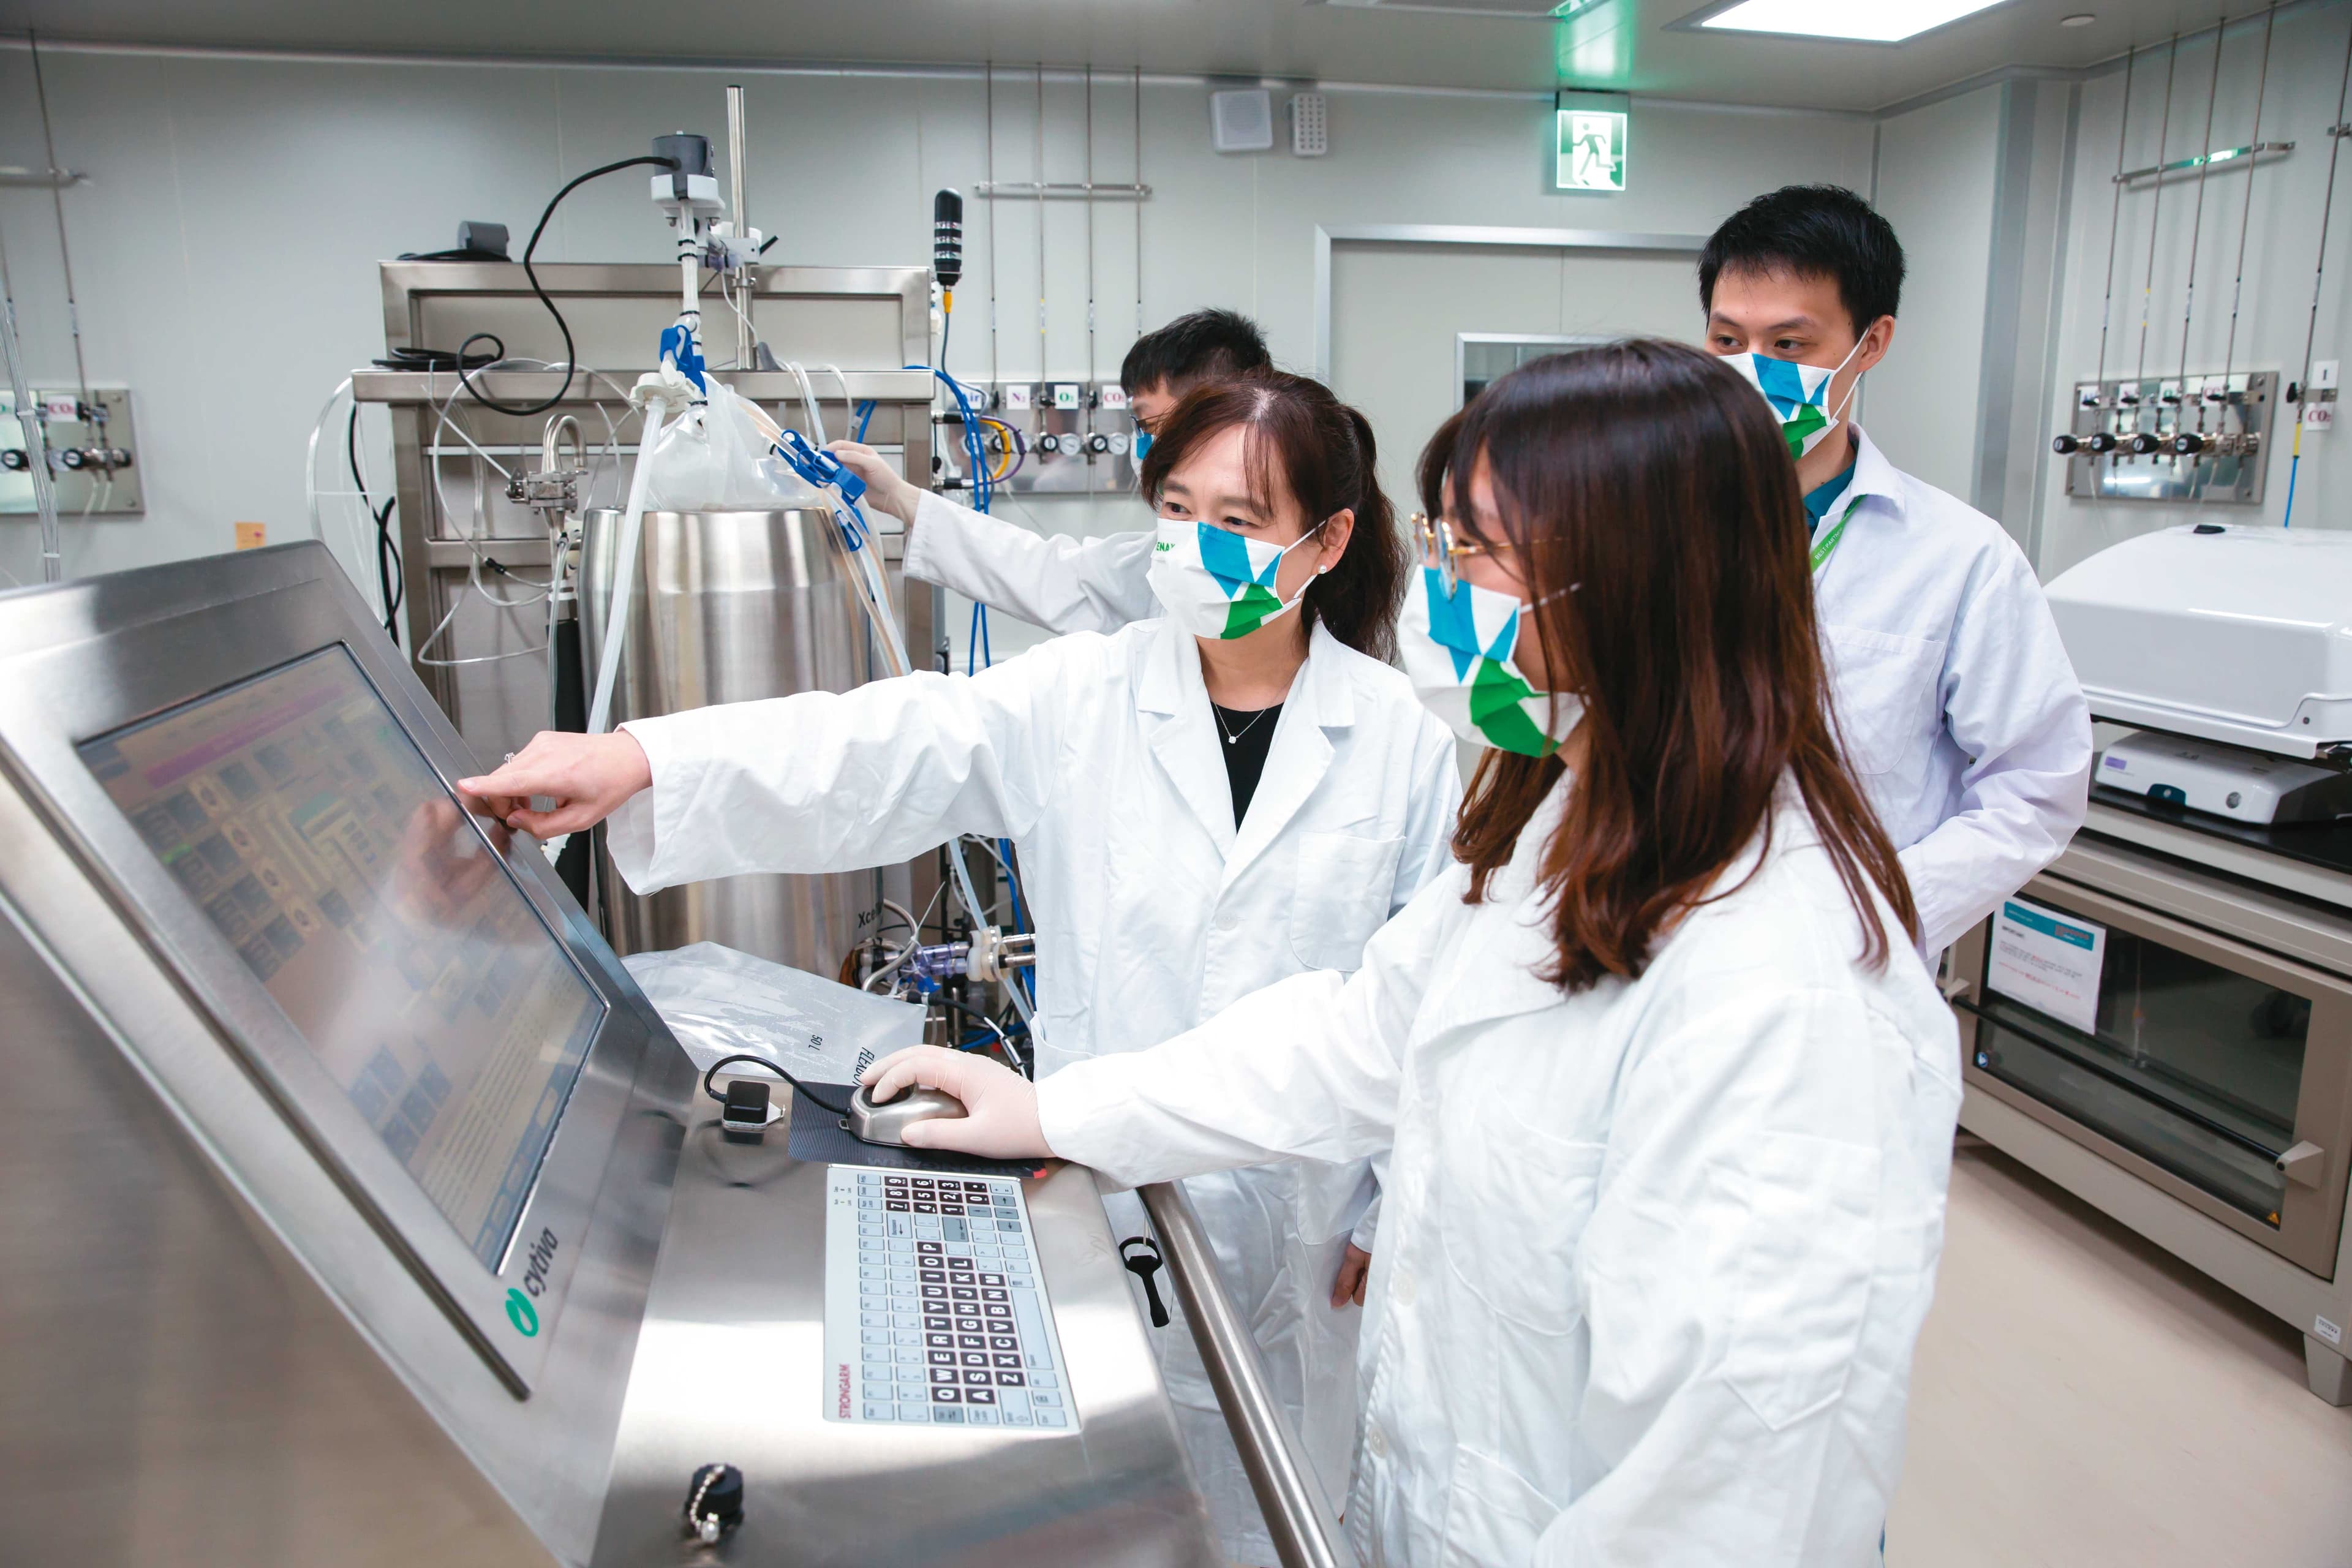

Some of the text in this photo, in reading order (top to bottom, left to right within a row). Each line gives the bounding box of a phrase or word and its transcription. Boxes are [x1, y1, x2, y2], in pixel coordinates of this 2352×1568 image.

[1815, 546, 1826, 560] BEST
[524, 1226, 559, 1298] cytiva
[924, 1257, 939, 1266] O
[927, 1287, 943, 1295] U
[929, 1302, 944, 1311] Y
[960, 1305, 975, 1313] H
[930, 1318, 946, 1327] T
[962, 1320, 978, 1330] G
[985, 1275, 1019, 1383] Z X C V B N M
[932, 1335, 948, 1344] R
[964, 1337, 981, 1346] F
[933, 1353, 951, 1362] E
[967, 1354, 983, 1364] D
[935, 1369, 952, 1381] W
[969, 1373, 986, 1382] S
[839, 1363, 851, 1419] STRONGARM
[937, 1389, 955, 1400] Q
[972, 1391, 989, 1401] A
